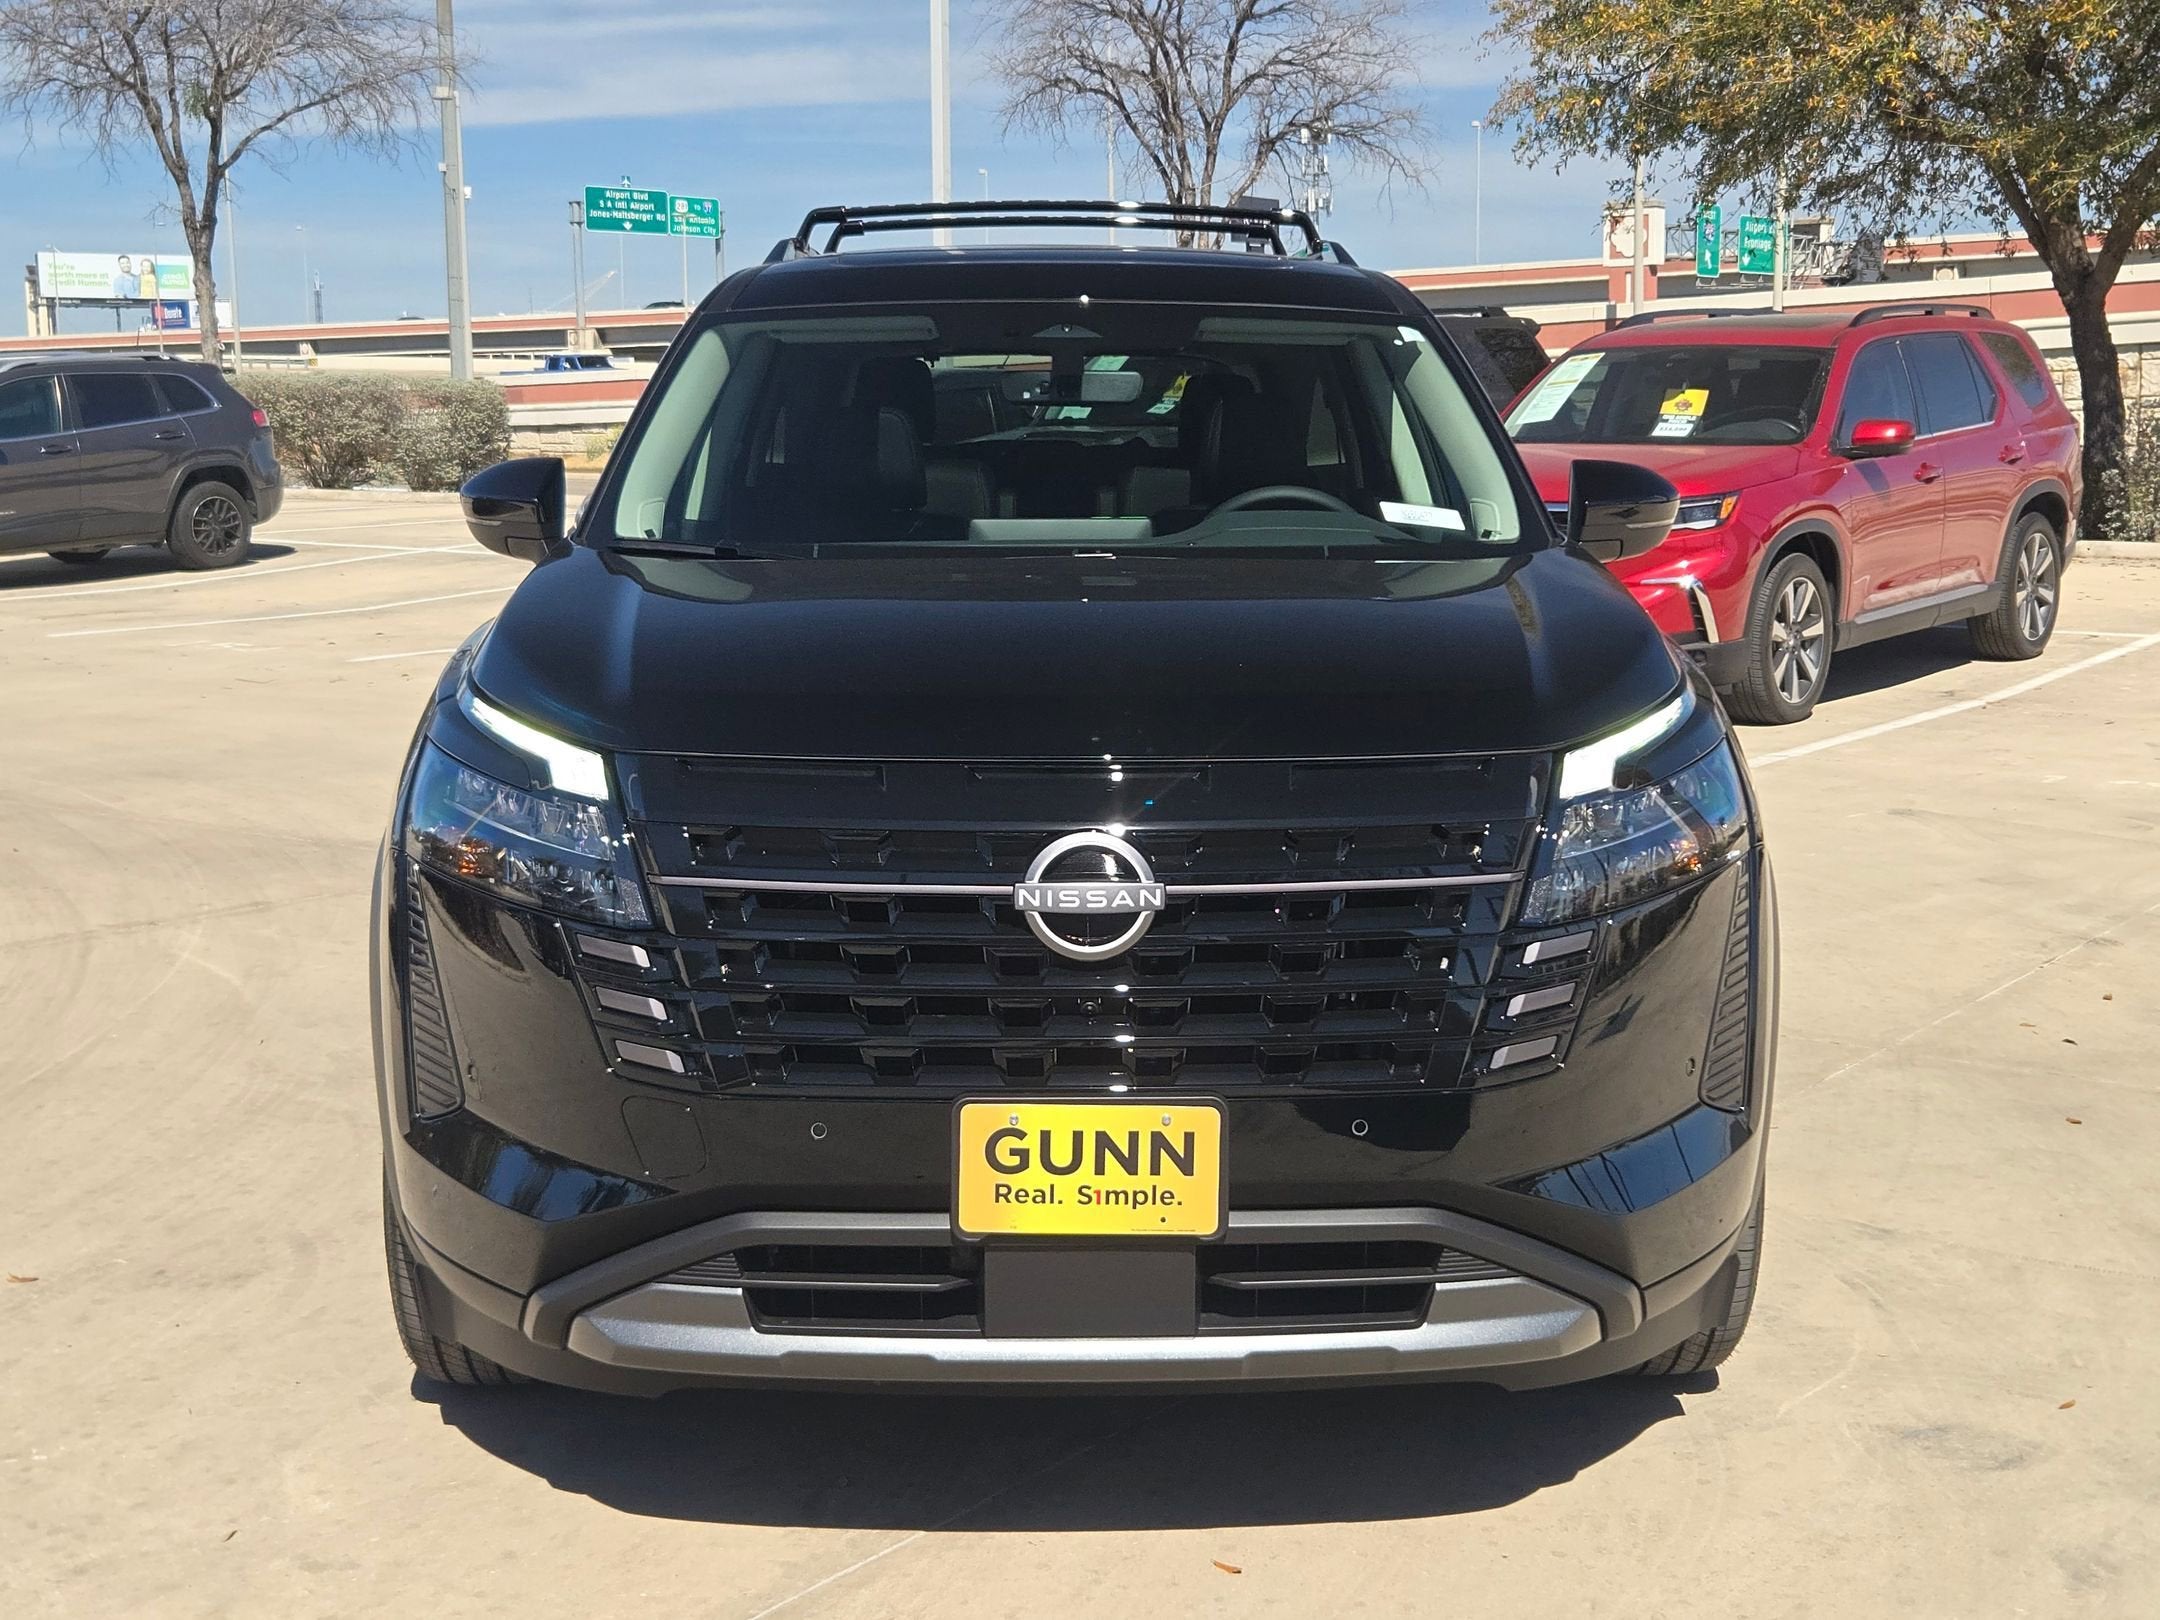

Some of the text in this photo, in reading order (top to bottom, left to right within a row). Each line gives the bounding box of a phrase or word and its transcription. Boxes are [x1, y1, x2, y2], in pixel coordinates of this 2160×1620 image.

[605, 190, 649, 201] Airport Blvd
[599, 200, 604, 208] S
[606, 200, 612, 208] A
[630, 202, 655, 212] Airport
[589, 209, 666, 222] Jones-Maltsberger Rd
[703, 226, 716, 236] City
[1744, 221, 1767, 234] Airport
[1018, 888, 1162, 908] NISSAN
[984, 1127, 1195, 1177] GUNN
[994, 1183, 1063, 1205] Real.
